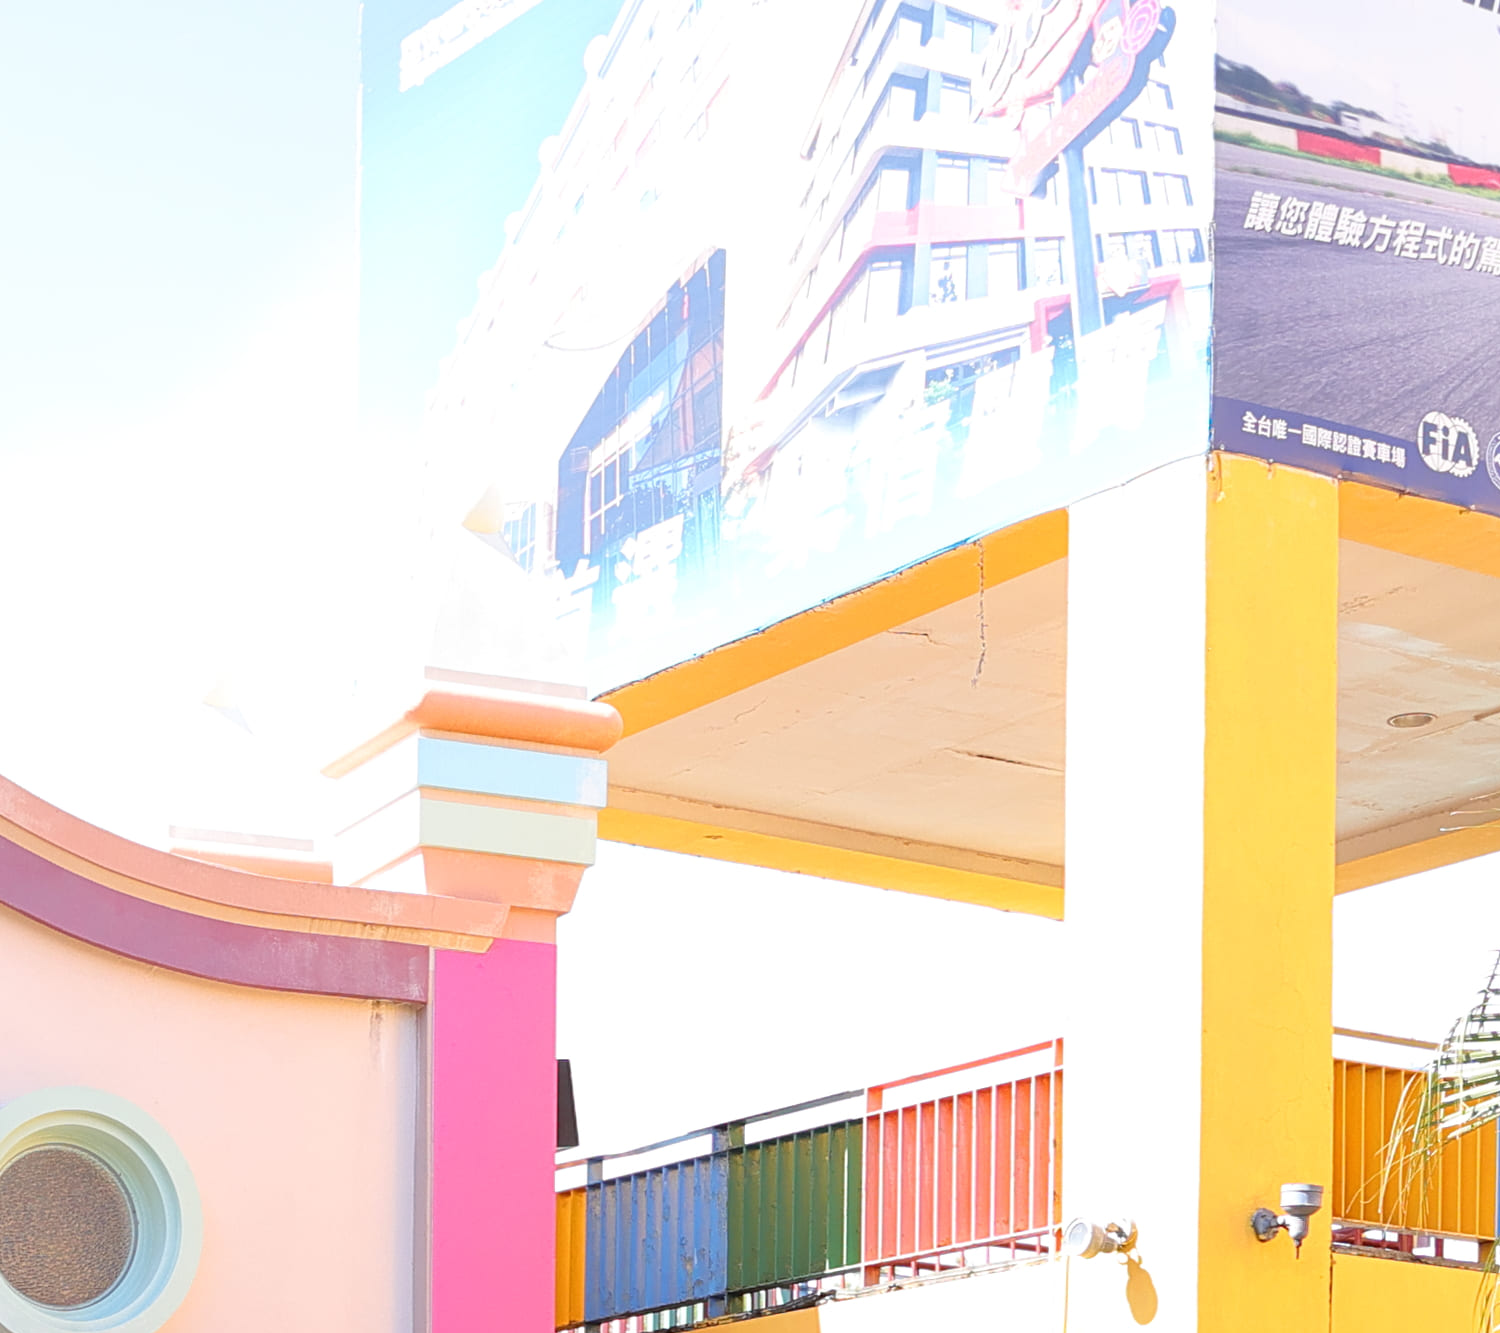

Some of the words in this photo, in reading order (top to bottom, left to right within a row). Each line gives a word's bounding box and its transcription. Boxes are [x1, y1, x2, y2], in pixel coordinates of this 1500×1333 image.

[1241, 410, 1407, 470] 全台唯一國際認證賽車場
